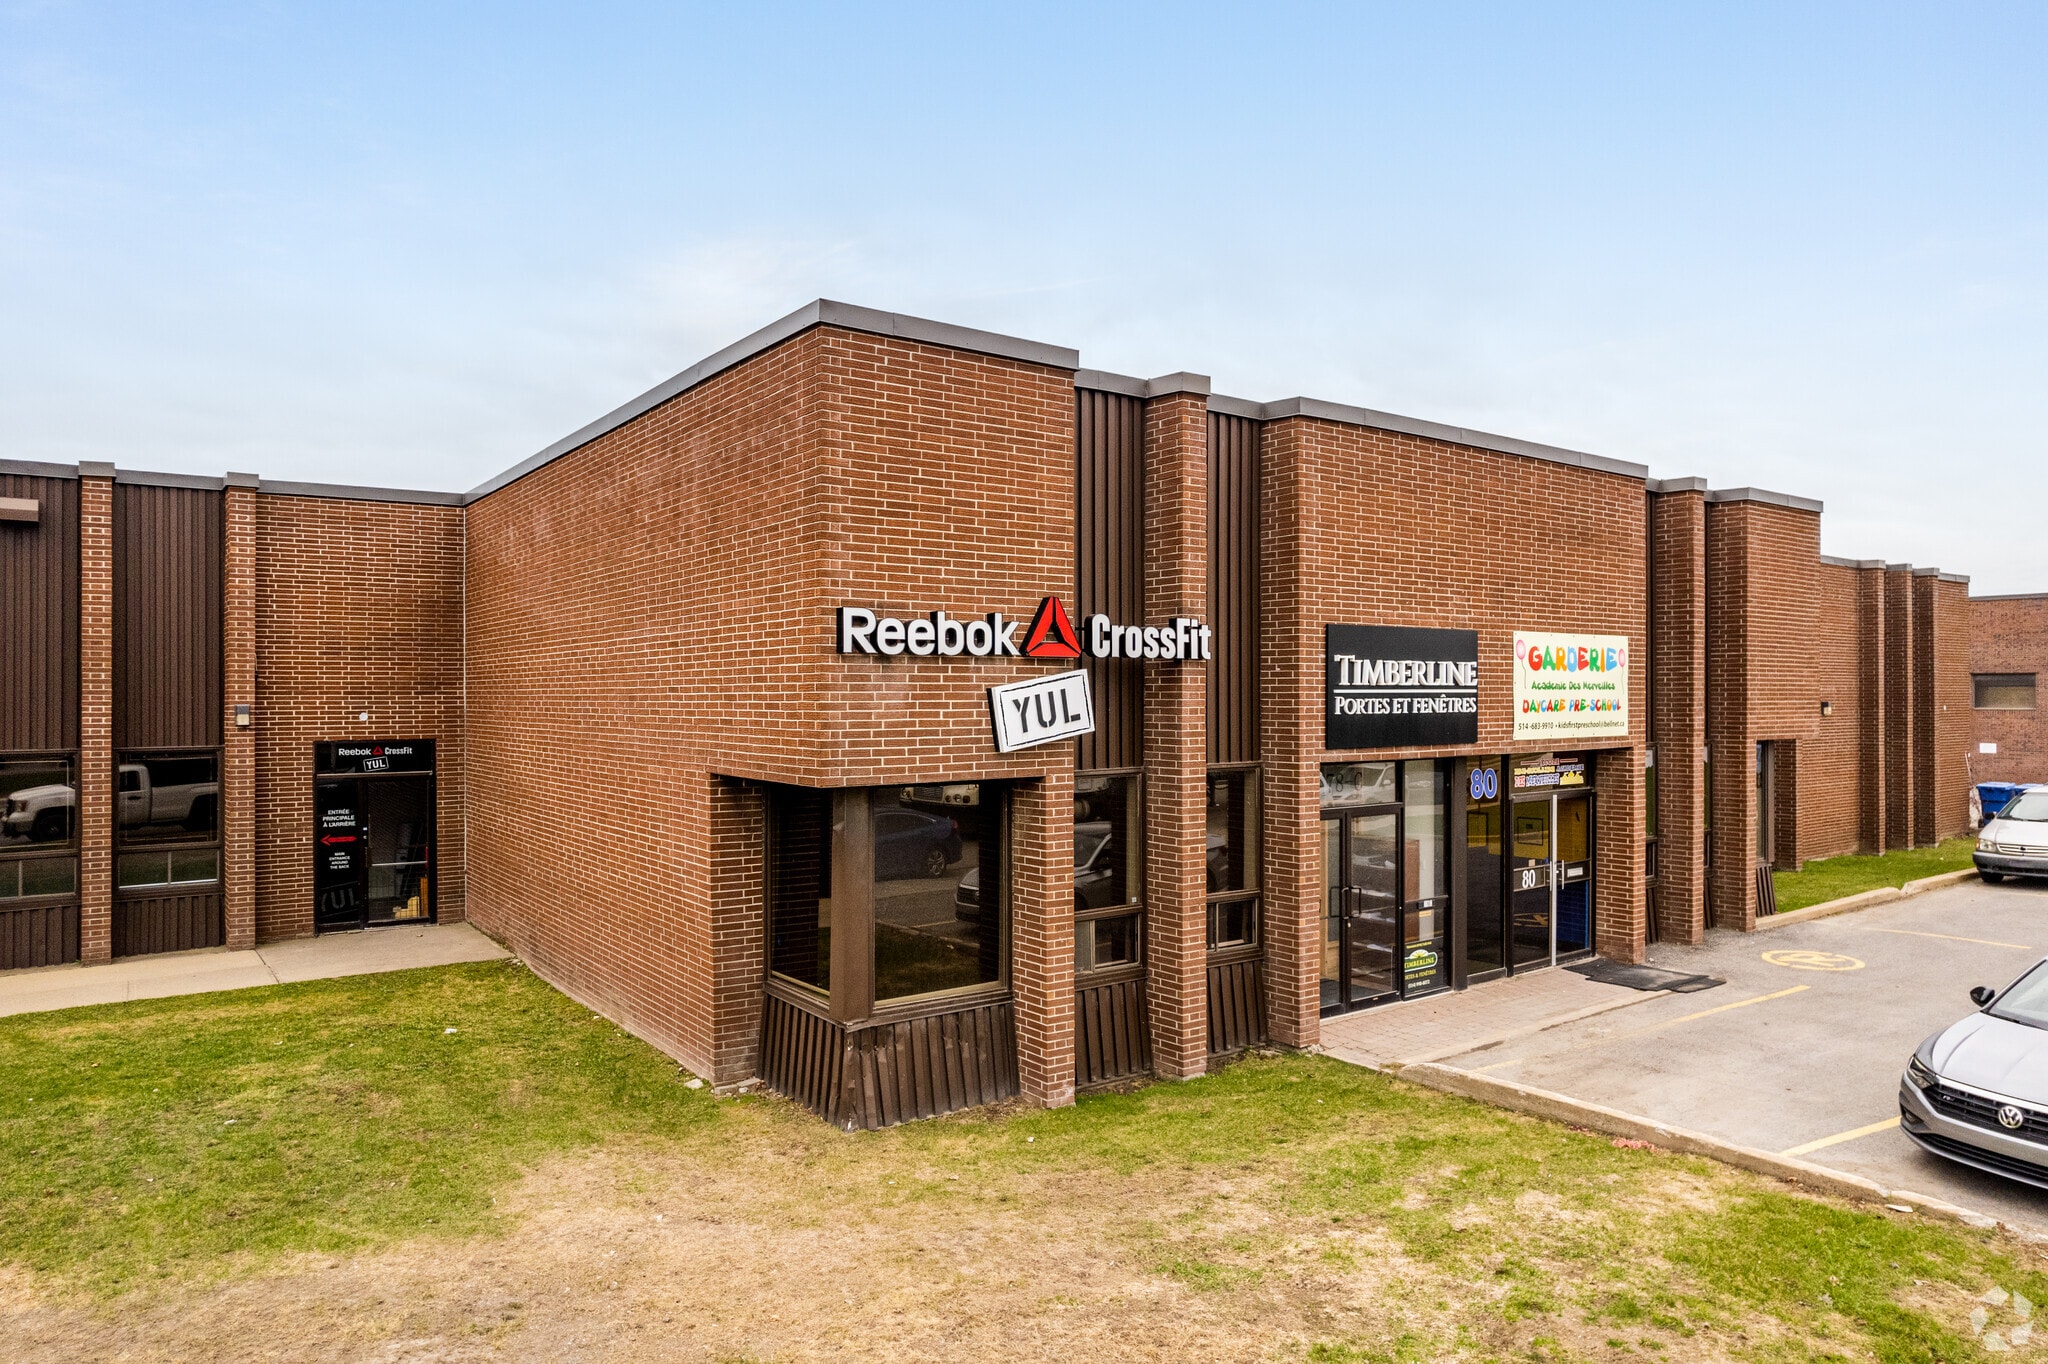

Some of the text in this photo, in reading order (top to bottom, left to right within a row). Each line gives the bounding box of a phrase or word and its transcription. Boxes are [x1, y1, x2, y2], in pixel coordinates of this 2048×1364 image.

[837, 606, 1212, 660] Reebok CrossFit
[1528, 645, 1618, 673] GARDERIE
[1334, 654, 1478, 686] TIMBERLINE
[1568, 681, 1581, 690] Des
[1012, 688, 1081, 733] YUL
[1334, 694, 1477, 715] PORTES ET FENÊTRES
[1522, 699, 1622, 714] DAYCARE PRE-SCHOOL
[338, 746, 413, 756] Reebok CrossFit
[366, 759, 386, 770] YUL
[1471, 768, 1498, 799] 80
[1522, 869, 1536, 889] 80
